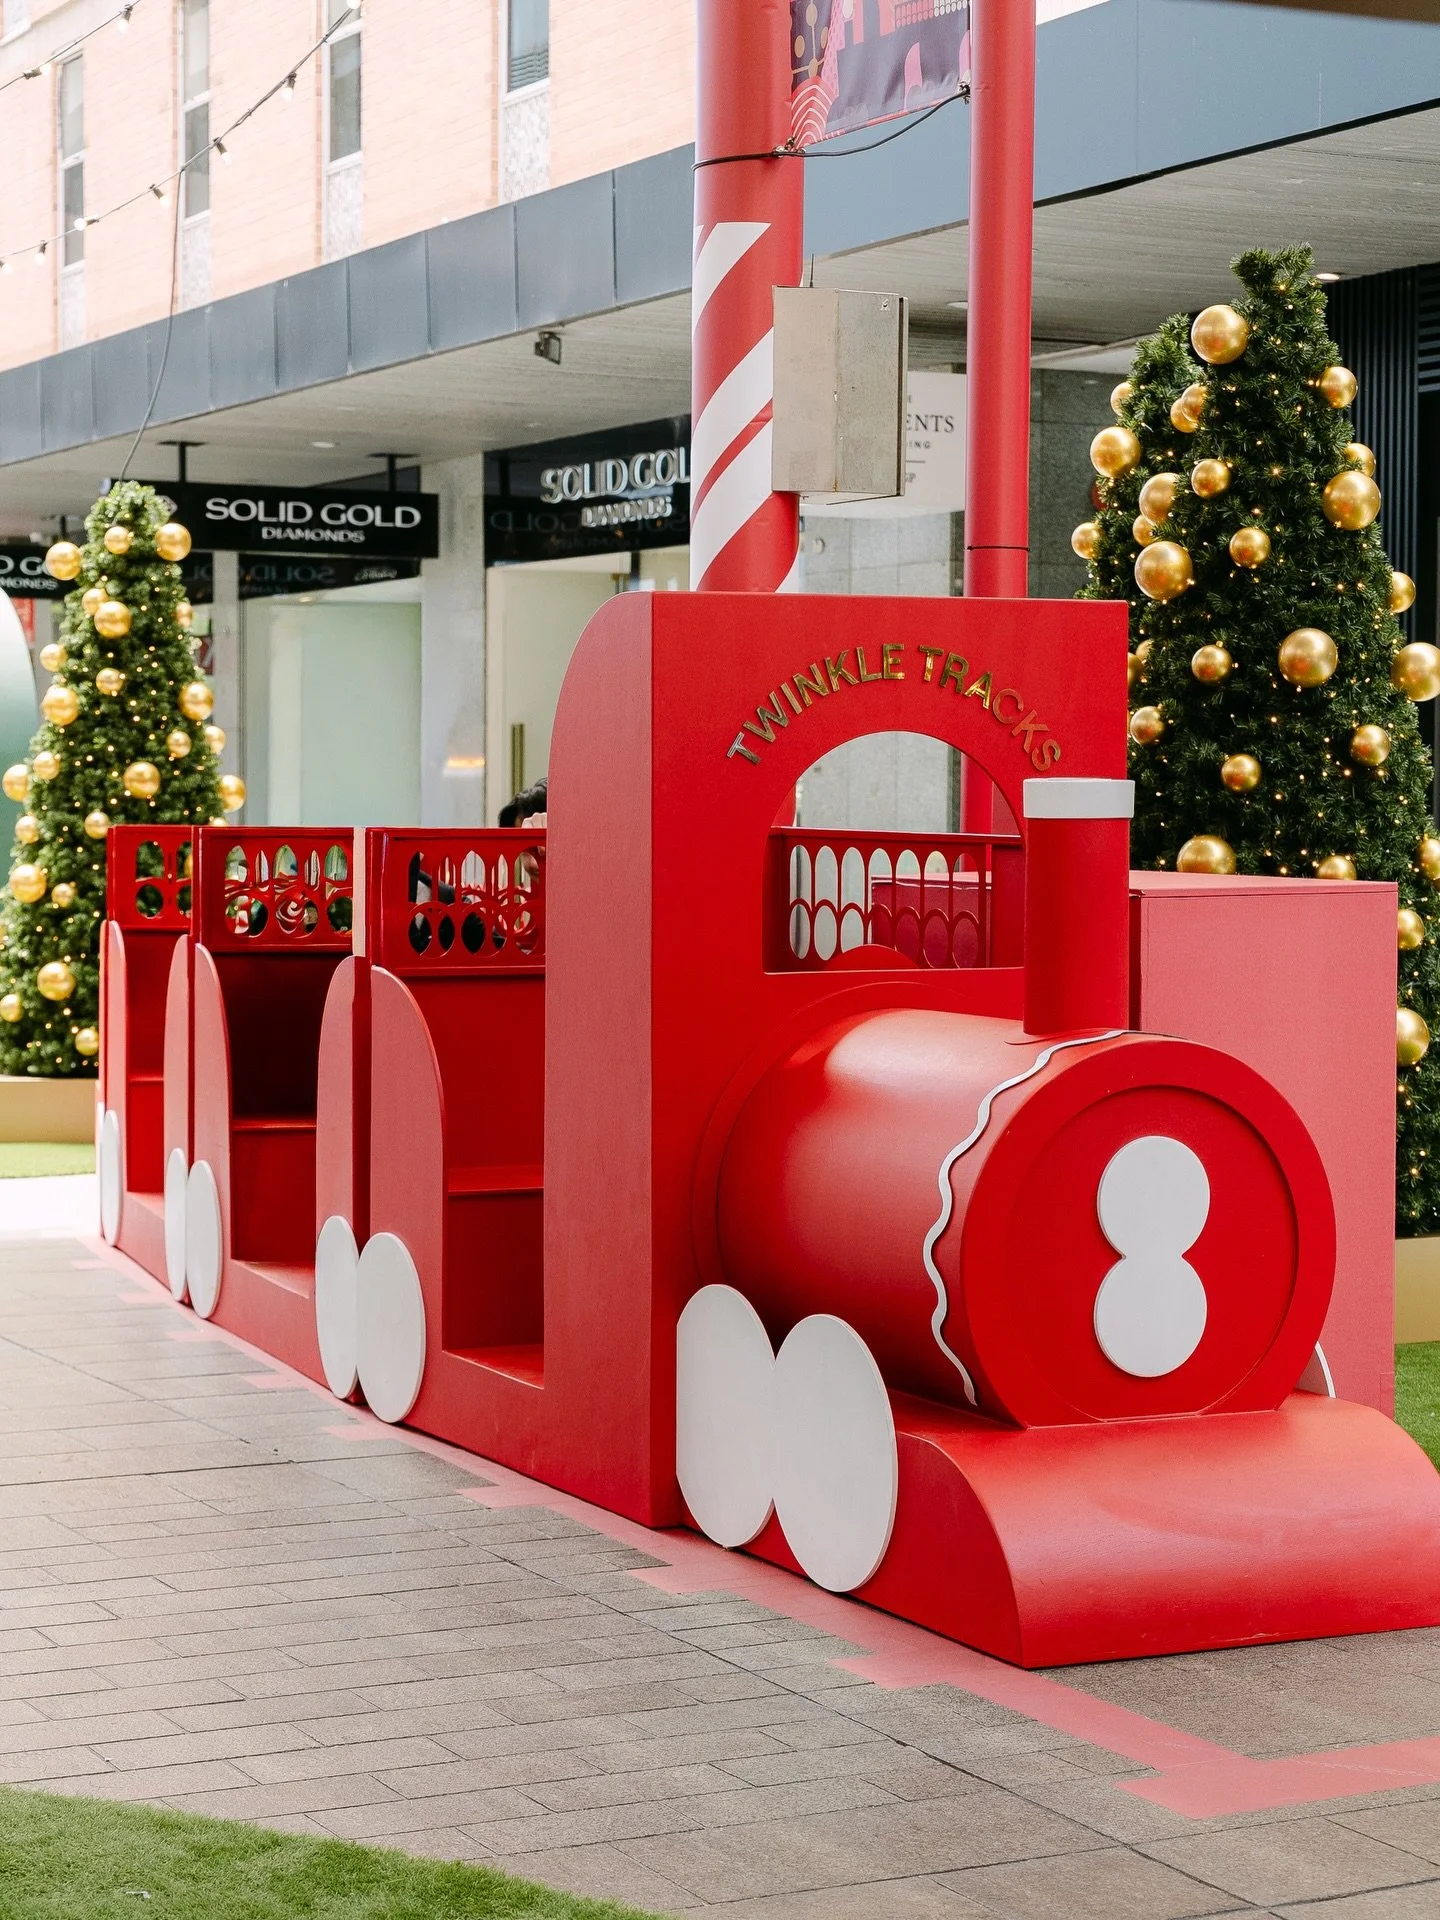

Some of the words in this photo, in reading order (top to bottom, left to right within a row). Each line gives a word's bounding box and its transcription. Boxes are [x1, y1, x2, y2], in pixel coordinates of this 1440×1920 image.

[540, 459, 629, 503] SOLID
[205, 497, 313, 524] SOLID
[320, 502, 422, 529] GOLD
[261, 526, 366, 543] DIAMONDS
[726, 643, 905, 765] TWINKLE
[919, 645, 1061, 771] TRACKS
